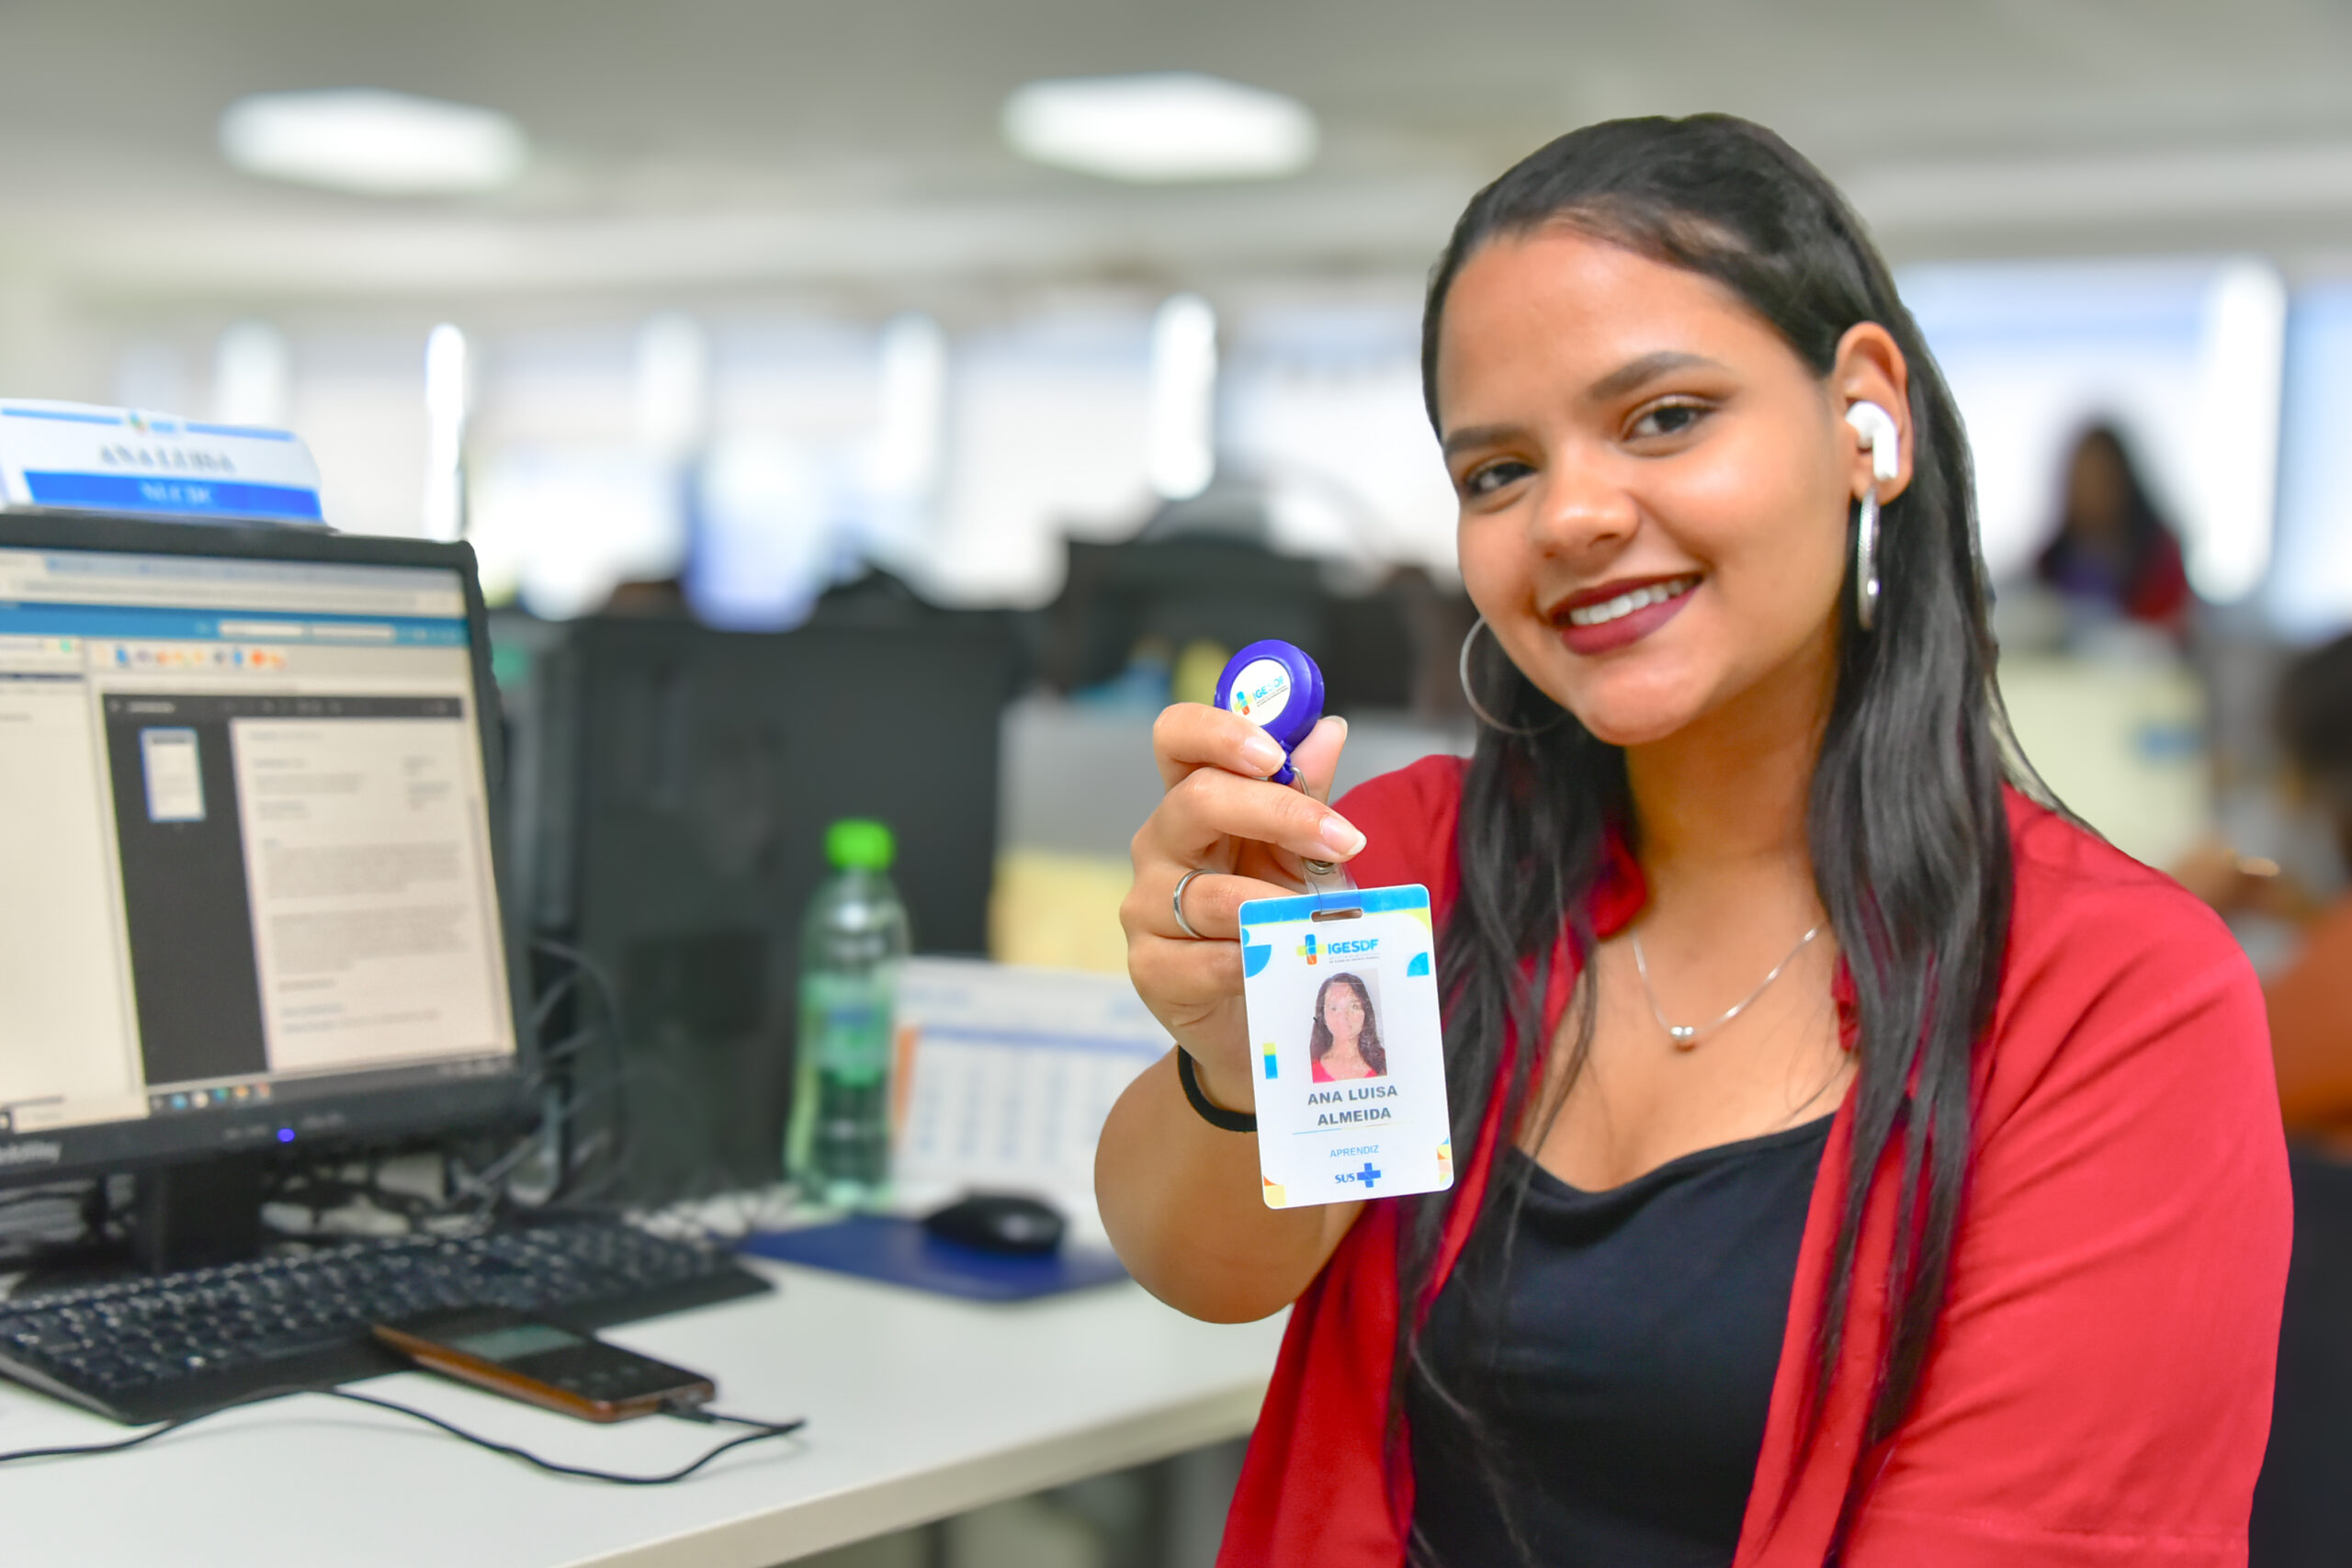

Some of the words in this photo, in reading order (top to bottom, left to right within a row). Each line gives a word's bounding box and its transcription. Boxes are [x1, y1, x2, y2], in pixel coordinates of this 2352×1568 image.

[1328, 939, 1379, 954] IGESDF
[1307, 1090, 1343, 1105] ANA
[1349, 1085, 1397, 1101] LUISA
[1317, 1107, 1392, 1126] ALMEIDA
[1329, 1145, 1379, 1158] APRENDIZ
[1335, 1172, 1355, 1184] SUS
